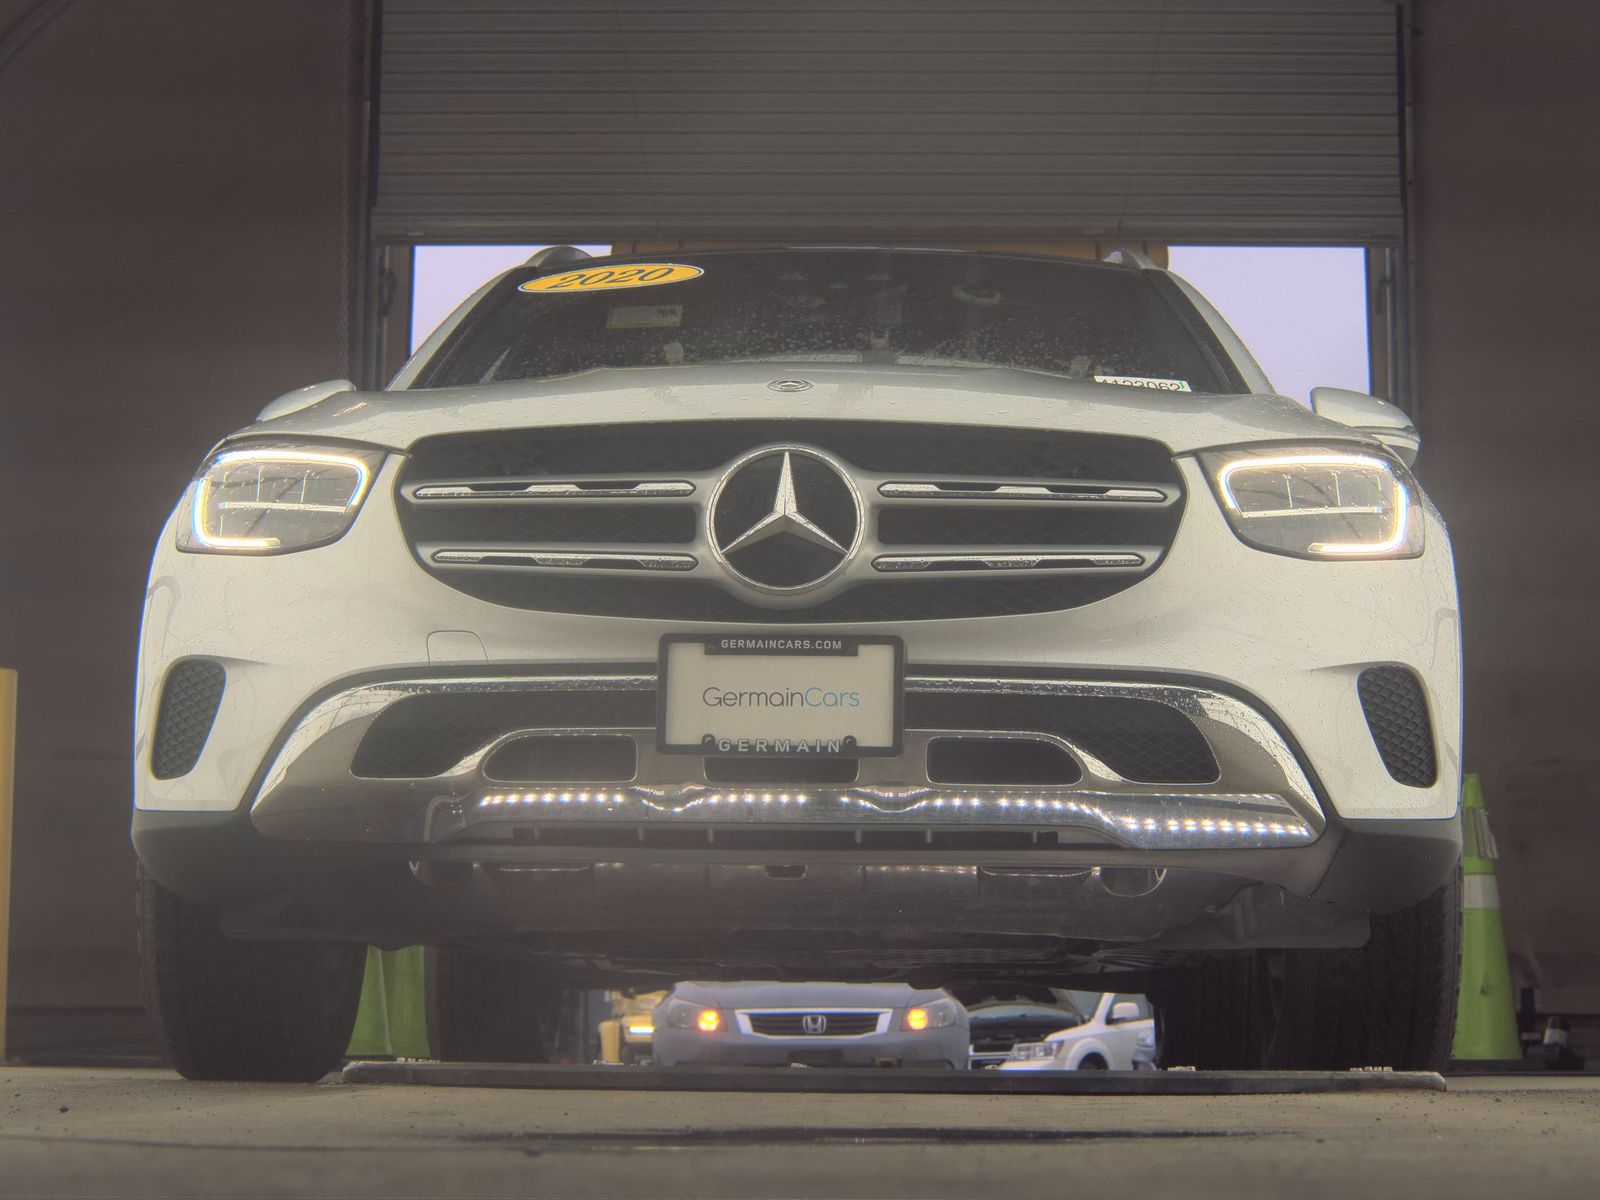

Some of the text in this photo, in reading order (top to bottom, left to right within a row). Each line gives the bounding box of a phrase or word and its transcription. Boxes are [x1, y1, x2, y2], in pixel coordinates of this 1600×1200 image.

[546, 267, 674, 290] 2020
[720, 639, 842, 650] GERMAINCARS.COM
[702, 686, 860, 707] GermainCars
[718, 737, 841, 753] GERMAIN
